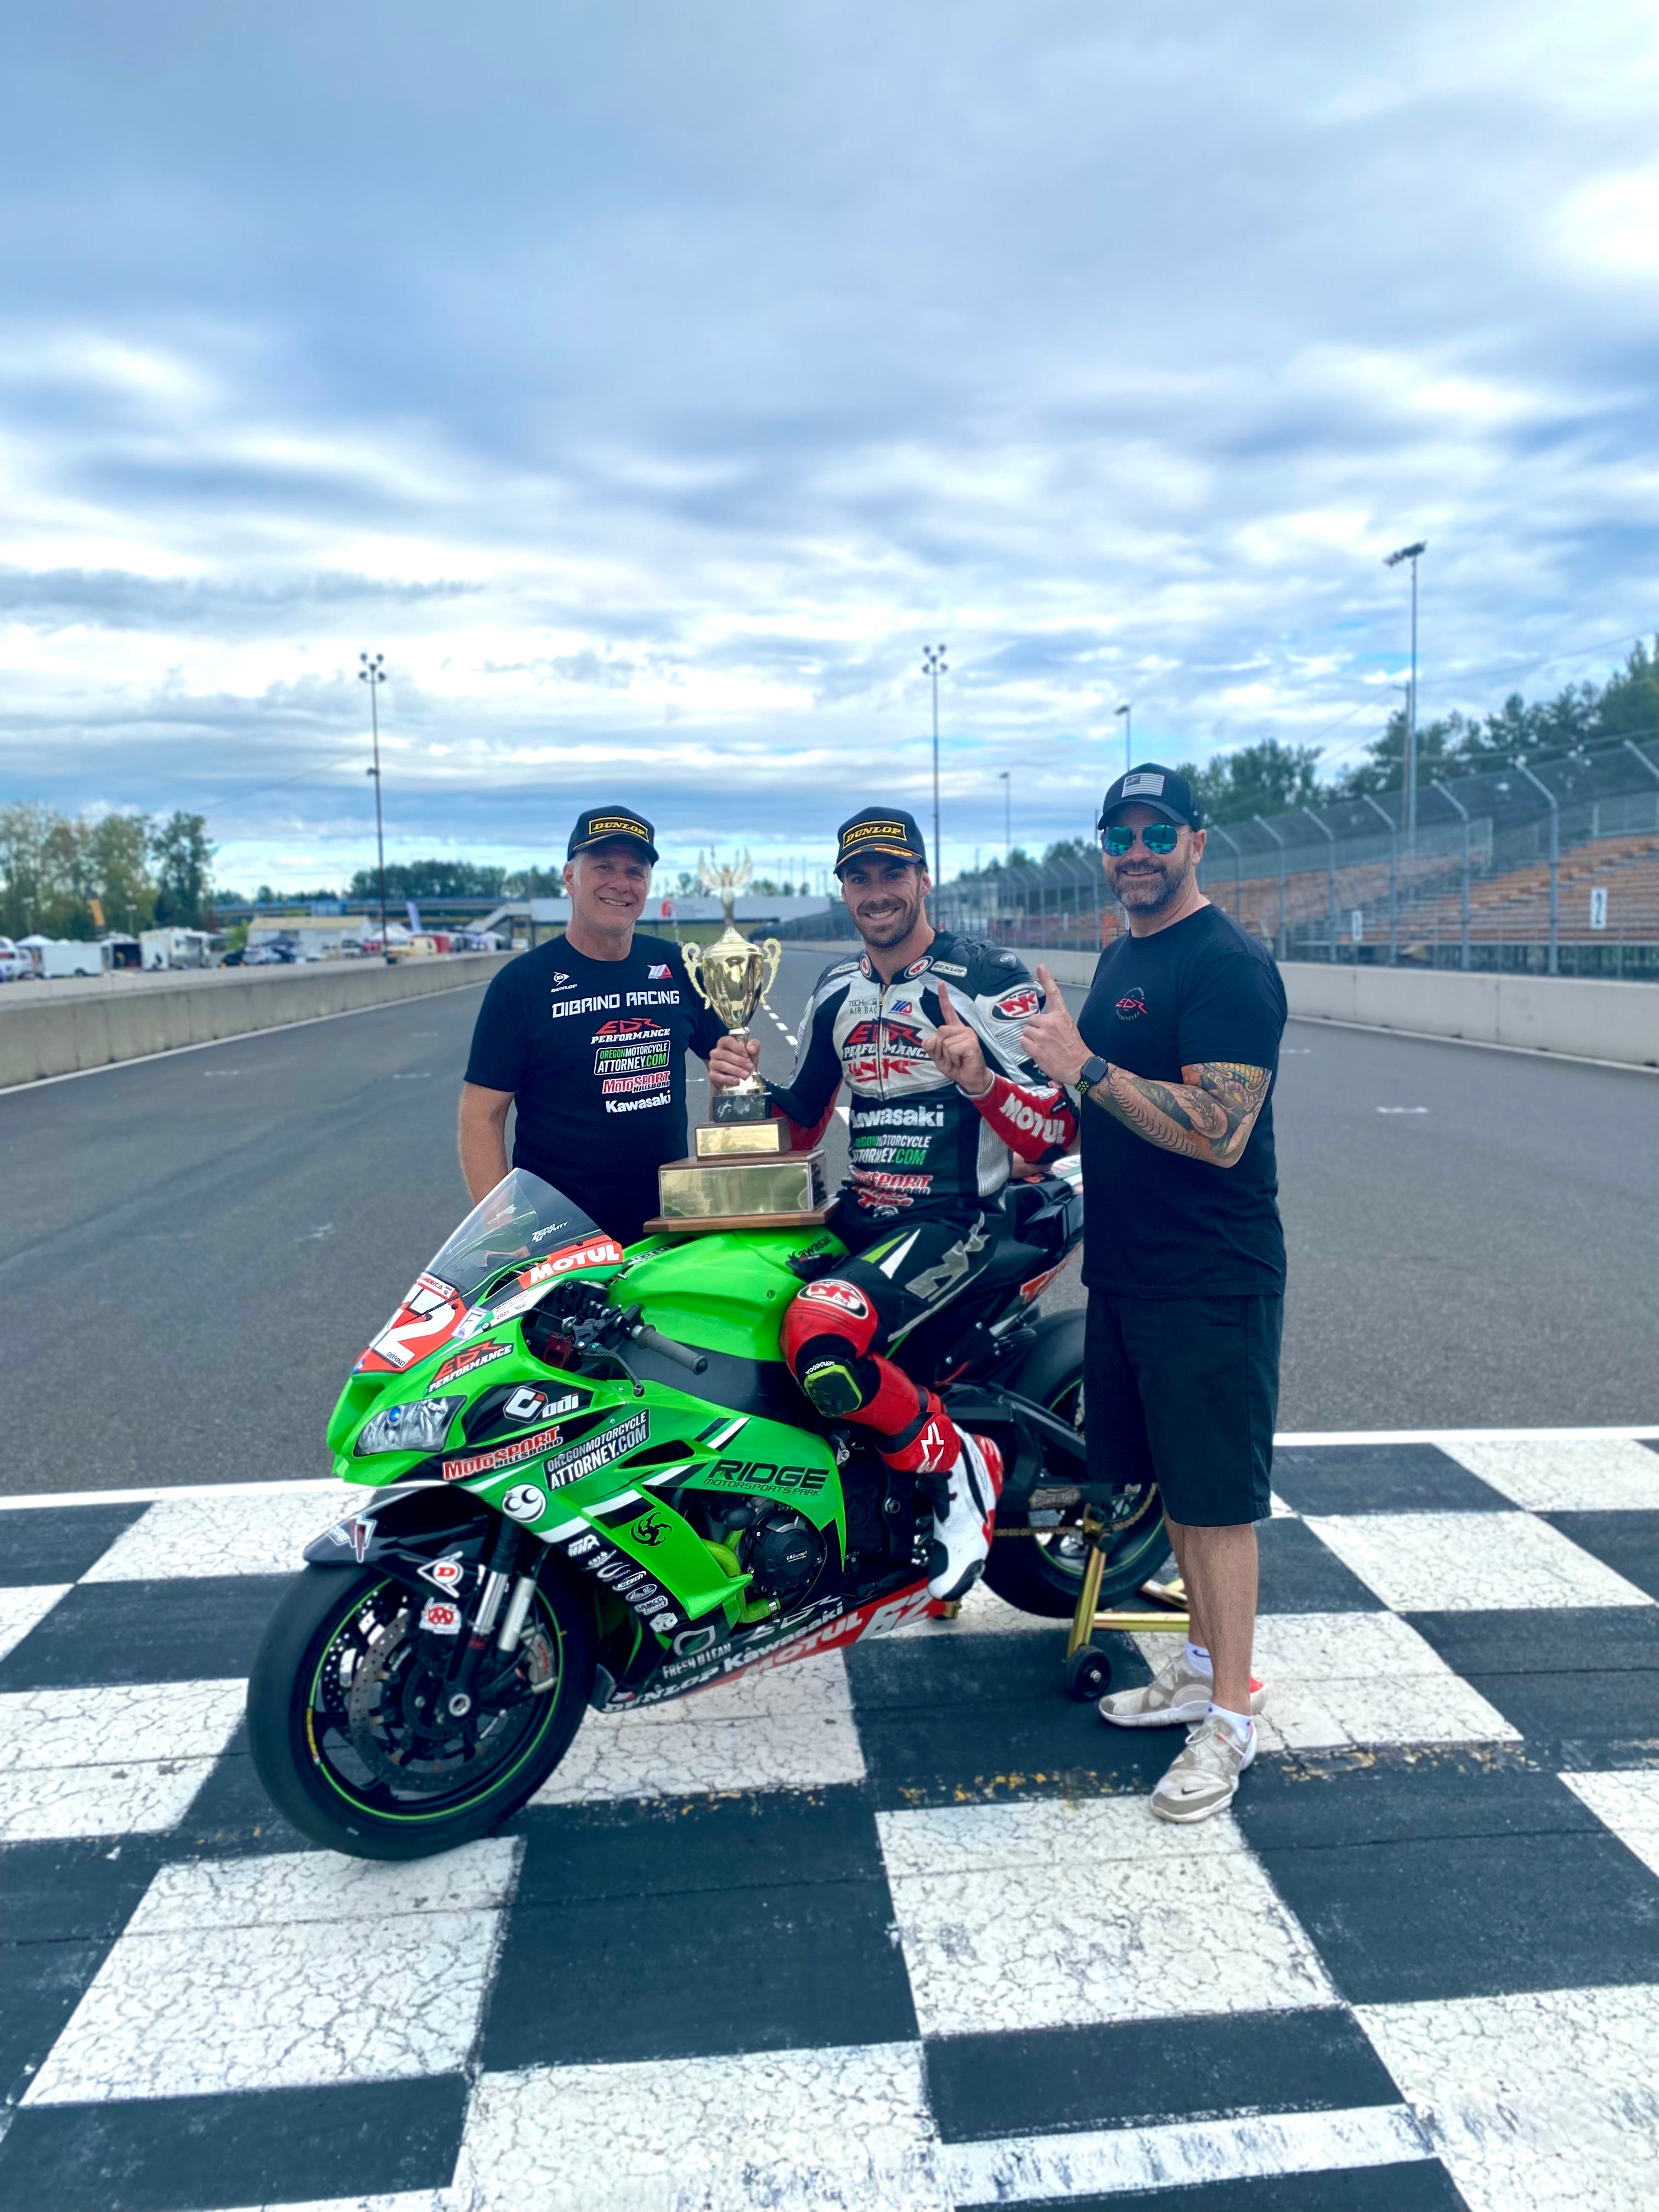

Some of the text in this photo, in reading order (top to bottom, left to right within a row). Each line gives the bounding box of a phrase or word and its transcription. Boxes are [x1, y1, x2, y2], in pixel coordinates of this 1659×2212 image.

[593, 822, 645, 835] DUNLOP
[845, 826, 901, 843] DUNLOP
[934, 964, 966, 973] DUNLOP
[550, 984, 577, 992] DUNLOP
[552, 990, 680, 1018] DIBRINO RACING
[590, 1028, 670, 1045] PERFORMANCE
[600, 1042, 668, 1059] OREGONMOTORCYCLE
[597, 1053, 667, 1074] ATTORNEY.COM
[633, 1081, 670, 1092] HILLSBORO
[605, 1090, 671, 1113] Kawasaki
[999, 1092, 1066, 1144] MOTUL
[530, 1244, 619, 1284] MOTUL
[496, 1310, 510, 1320] 2021
[428, 1345, 512, 1393] PERFORMANCE
[494, 1437, 563, 1469] HILLSBORO
[548, 1412, 646, 1472] OREGONMOTORCYCLE
[551, 1424, 646, 1490] ATTORNEY.COM
[703, 1478, 821, 1497] MOTORSPORTS PARK
[708, 1459, 830, 1489] RIDGE
[855, 1587, 936, 1643] 62
[602, 1601, 844, 1713] DUNLOP Kawasaki
[742, 1611, 864, 1678] MOTUL
[662, 1659, 696, 1679] FRESH
[707, 1643, 731, 1662] LEAN
